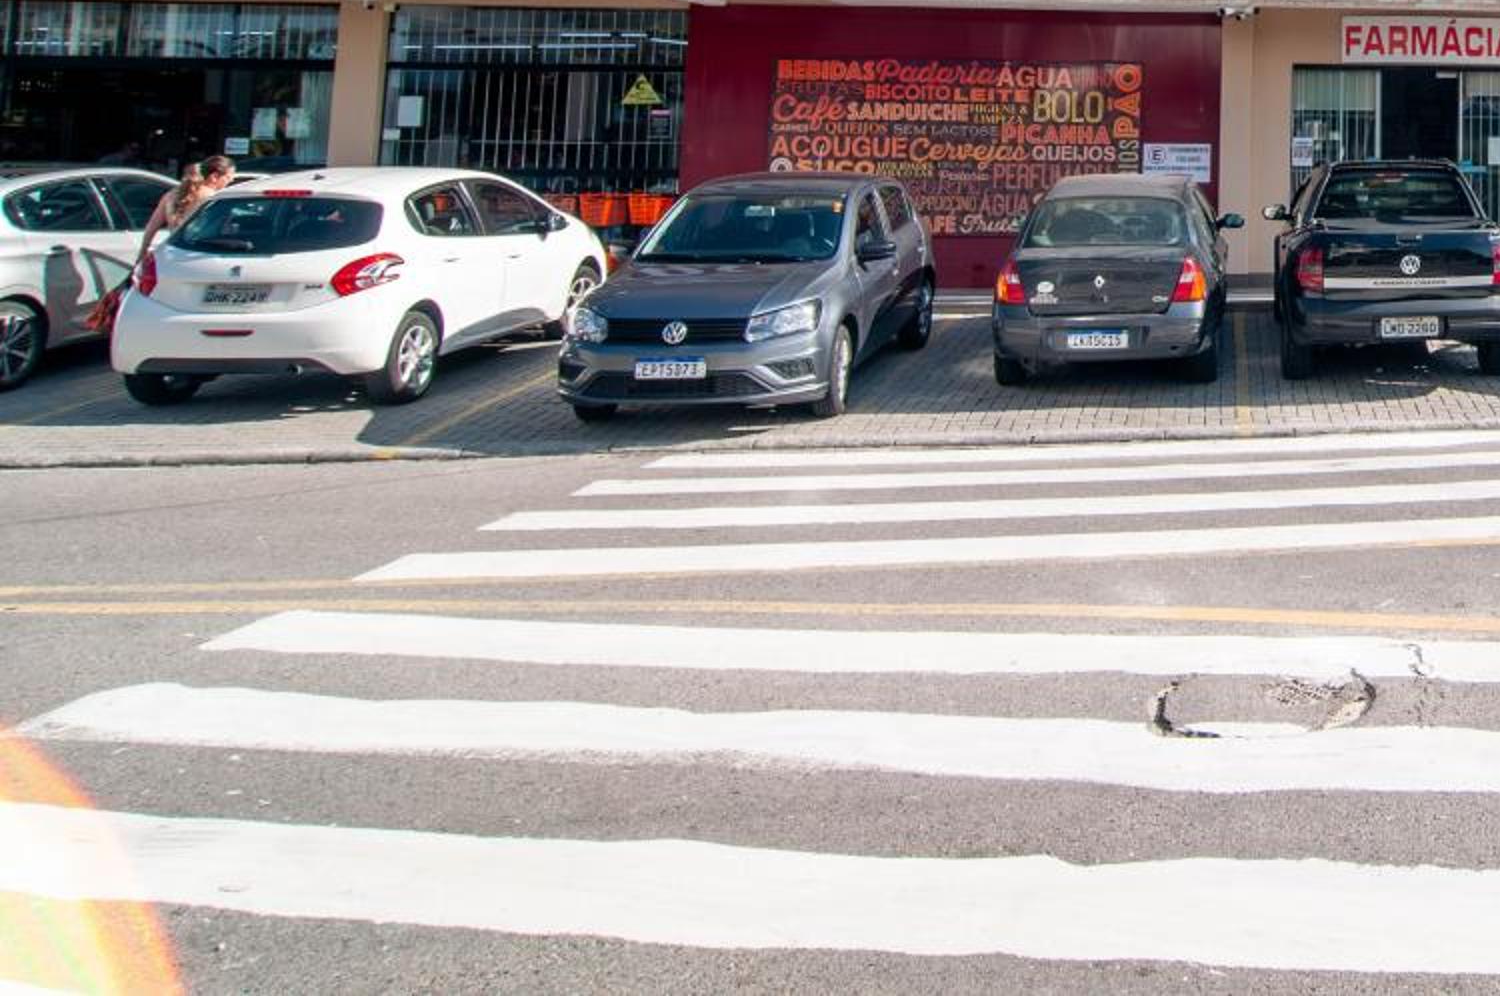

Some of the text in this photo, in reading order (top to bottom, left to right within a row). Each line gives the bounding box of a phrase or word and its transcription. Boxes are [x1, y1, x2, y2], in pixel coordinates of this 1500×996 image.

[778, 59, 875, 81] BEBIDAS
[876, 59, 999, 83] Padaria
[996, 61, 1073, 89] ÁGUA
[865, 83, 951, 101] BISCOITO
[953, 88, 1031, 103] LEITE
[1033, 89, 1105, 123] BOLO
[1108, 63, 1142, 139] PÃO
[773, 94, 970, 132] Café SANDUICHE
[825, 122, 889, 136] QUEIJOS
[1000, 124, 1112, 145] PICANHA
[908, 137, 1030, 171] Cervejas
[1031, 145, 1116, 162] QUEIJOS
